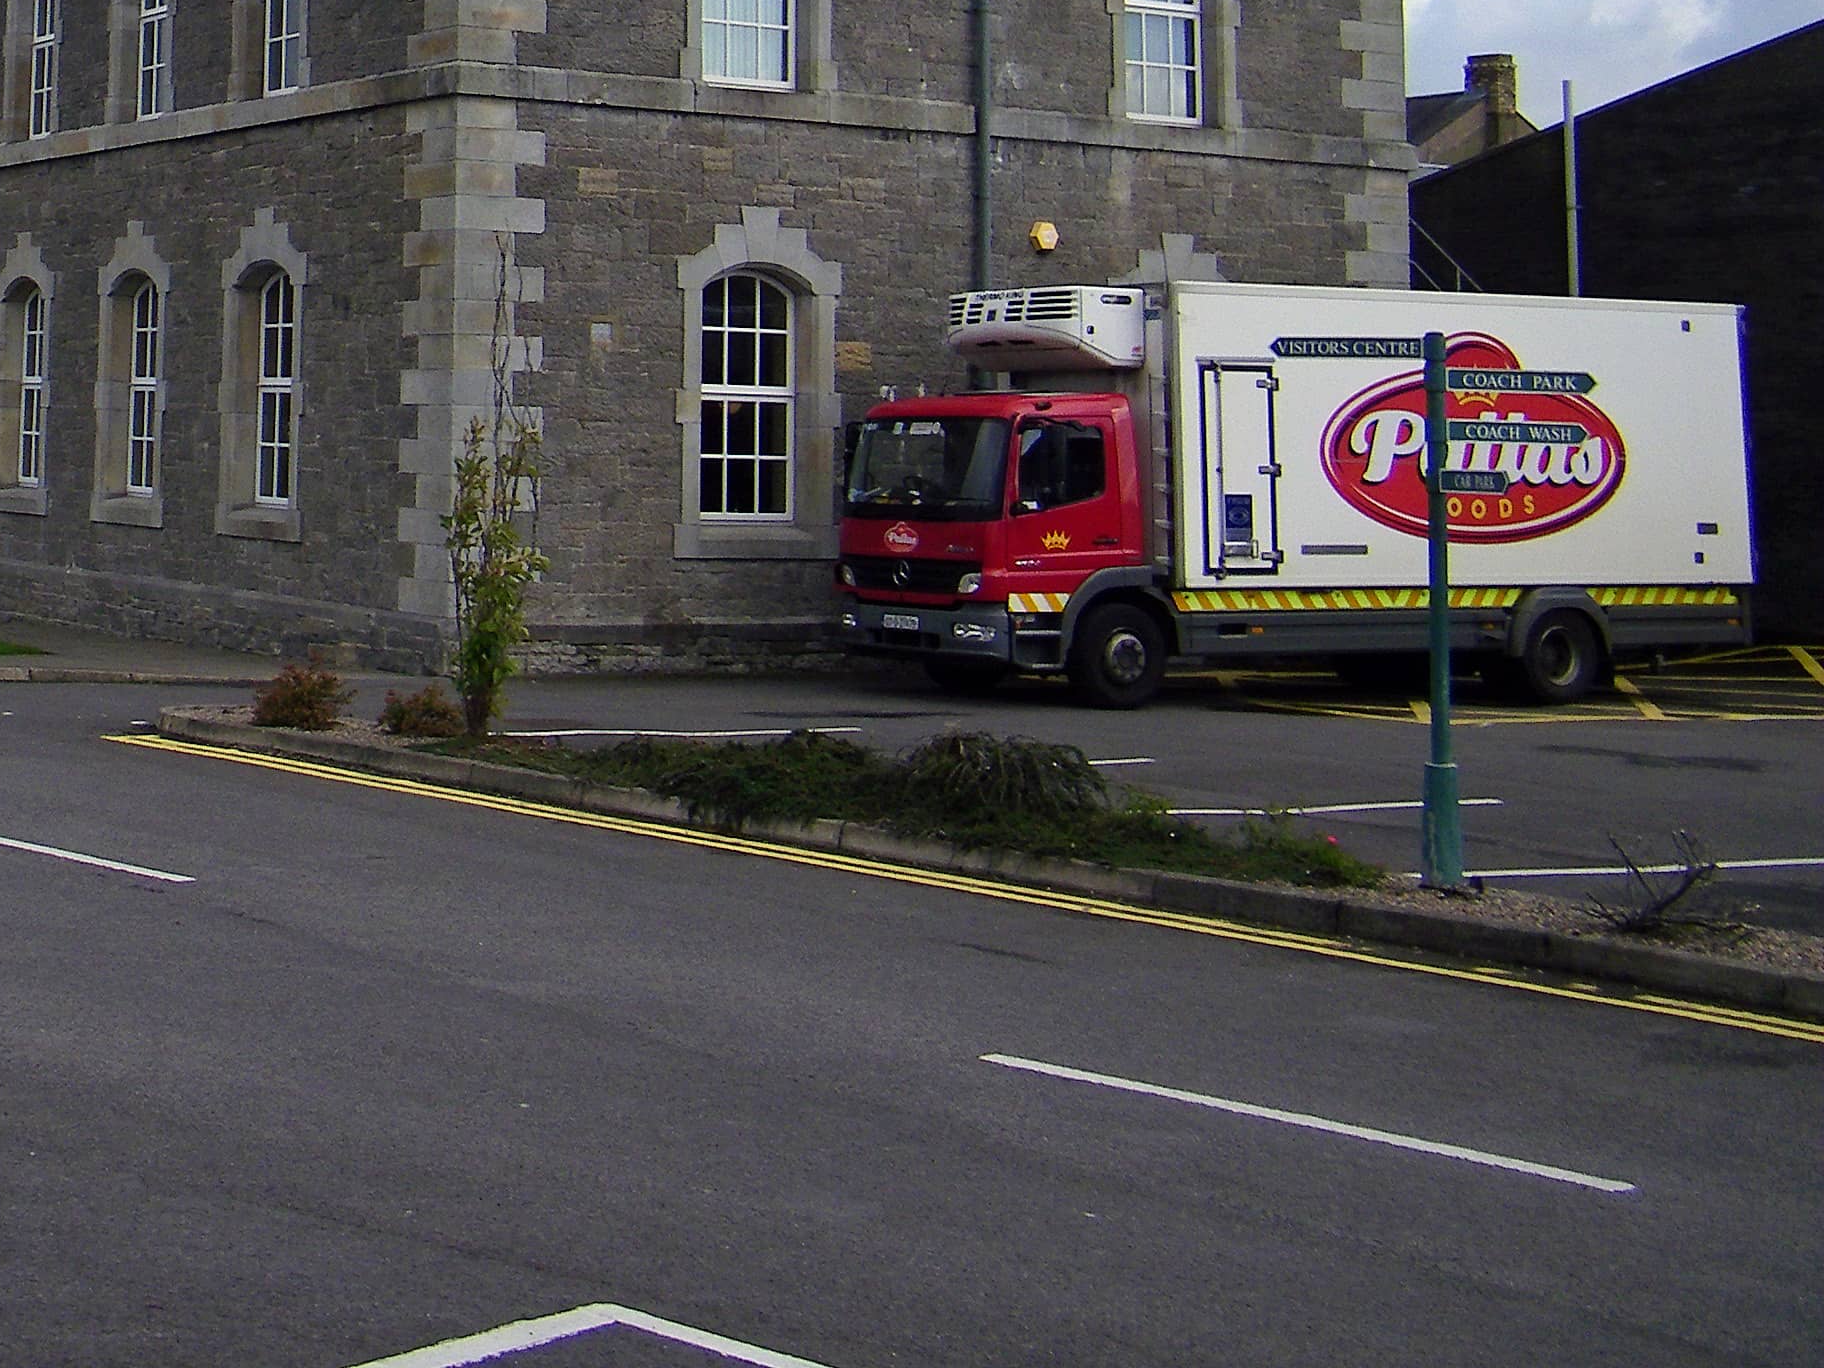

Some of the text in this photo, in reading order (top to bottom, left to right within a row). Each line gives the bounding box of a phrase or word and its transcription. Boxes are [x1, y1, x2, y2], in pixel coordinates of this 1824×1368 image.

[1276, 338, 1420, 357] VISITORS CENTRE
[1462, 372, 1578, 391] COACH PARK
[1464, 424, 1573, 442] COACH WASH
[1446, 496, 1535, 519] OODS
